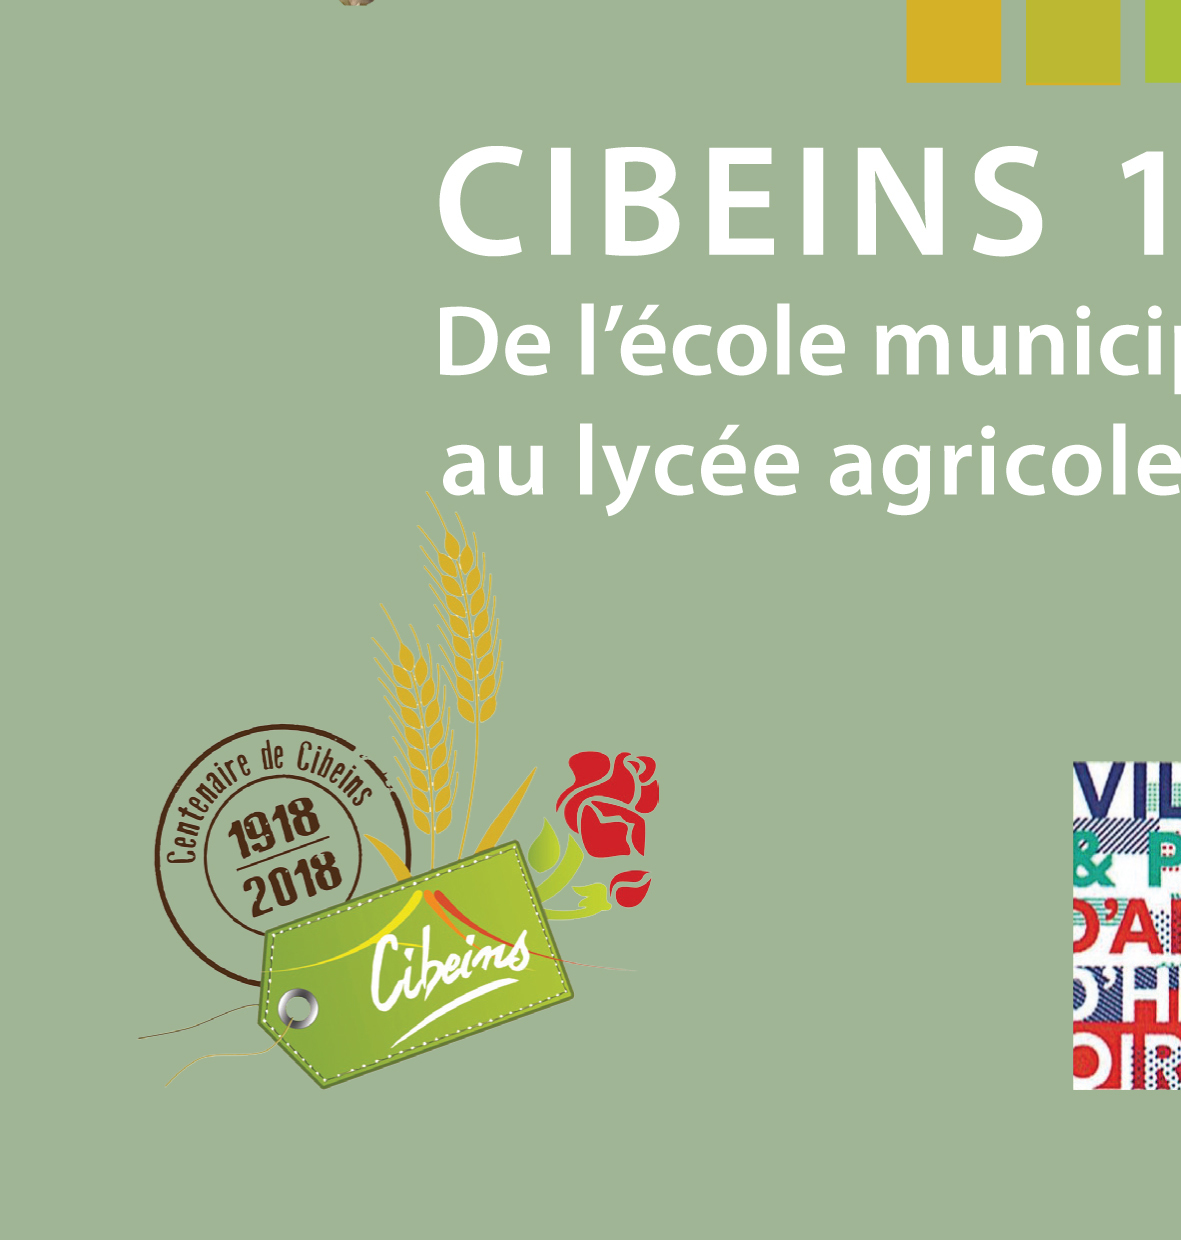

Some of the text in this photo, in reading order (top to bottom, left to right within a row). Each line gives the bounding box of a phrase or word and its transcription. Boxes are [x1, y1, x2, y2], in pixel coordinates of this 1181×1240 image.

[440, 146, 1043, 257] CIBEINS
[439, 306, 551, 376] De
[581, 303, 846, 376] l’école
[442, 444, 544, 496] au
[579, 422, 800, 517] lycée
[166, 739, 373, 864] Centenaire de Cibeins
[228, 797, 321, 860] 1918
[242, 850, 343, 918] 2018
[1073, 829, 1116, 888] &
[371, 924, 531, 1012] Cibeins
